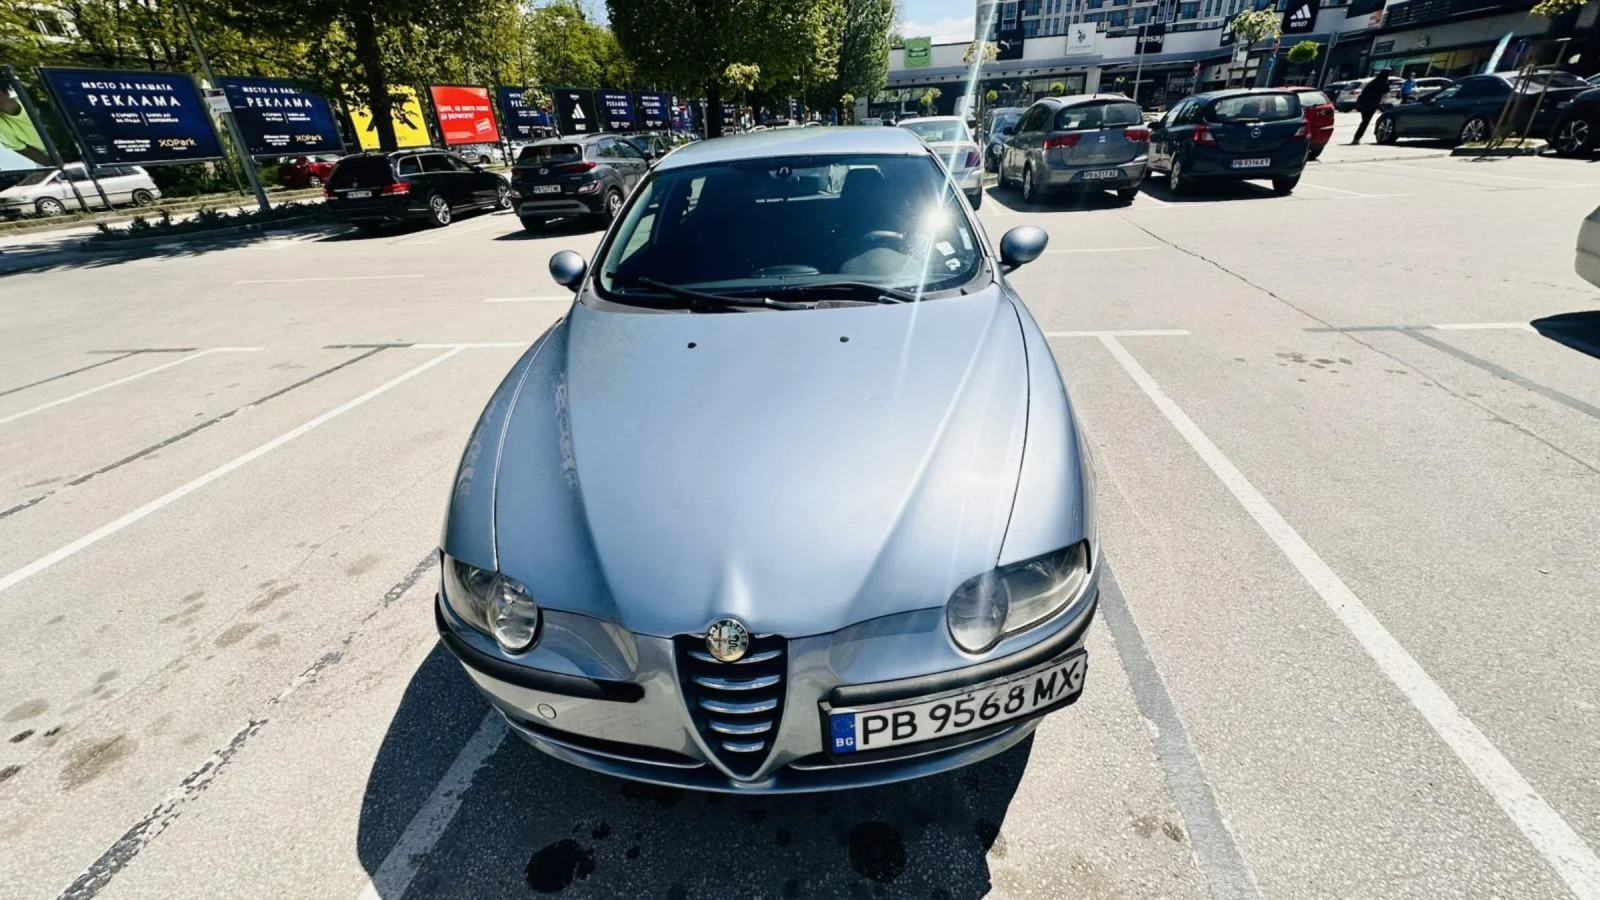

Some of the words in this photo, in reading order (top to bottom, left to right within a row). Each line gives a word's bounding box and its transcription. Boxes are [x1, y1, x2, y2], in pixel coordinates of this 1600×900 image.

[120, 82, 133, 90] ЗА
[135, 83, 173, 91] ВАШАТА
[87, 94, 181, 106] РЕКЛАМА
[246, 97, 313, 108] РЕКЛАМА
[862, 711, 917, 745] PB
[929, 687, 1024, 733] 9568
[1033, 661, 1080, 706] MX
[836, 738, 853, 747] BG
